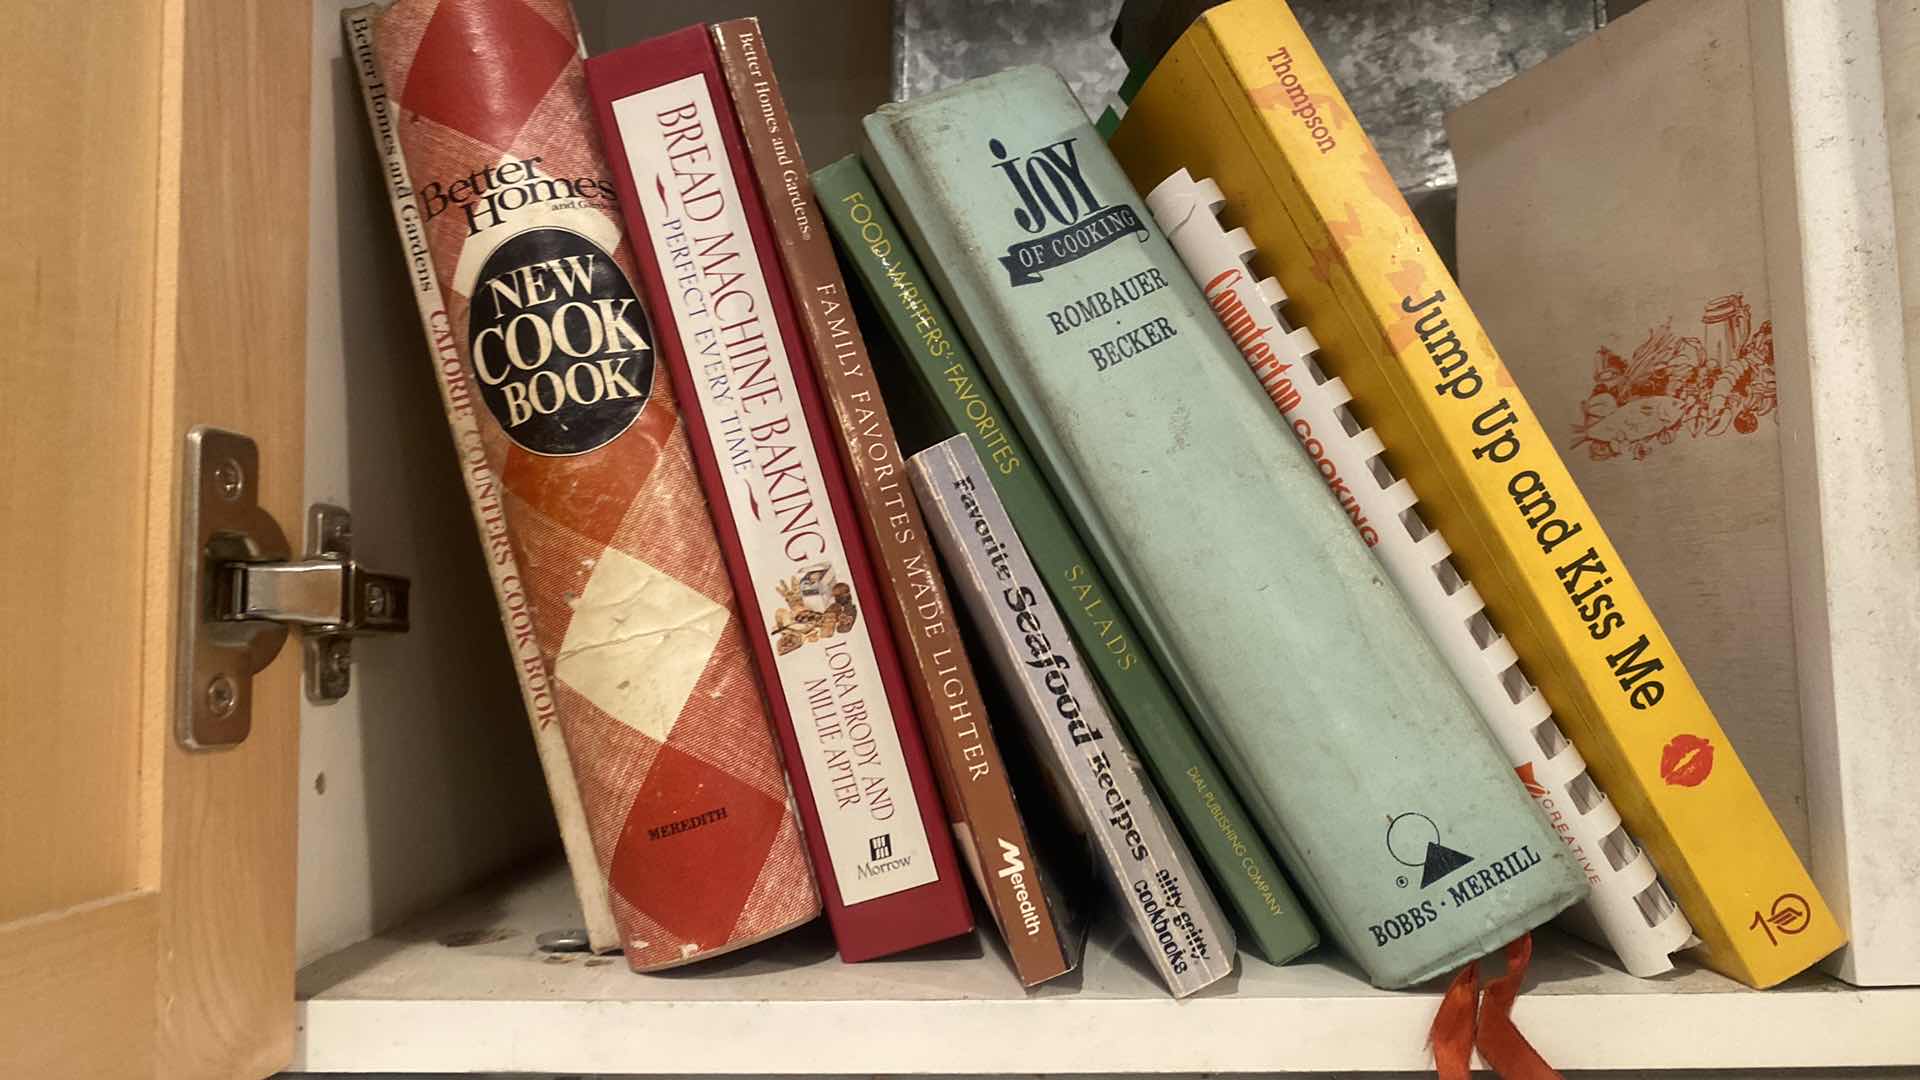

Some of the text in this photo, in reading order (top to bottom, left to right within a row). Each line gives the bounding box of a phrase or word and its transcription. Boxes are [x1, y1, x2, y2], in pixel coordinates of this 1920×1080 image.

[739, 31, 762, 77] Better
[754, 81, 778, 134] Homes
[772, 137, 793, 166] and
[1267, 47, 1337, 154] Thompson
[420, 156, 543, 223] Better
[462, 176, 617, 236] Homes
[1018, 208, 1137, 268] OF COOKING
[485, 254, 595, 319] NEW
[657, 101, 827, 565] BREAD MACHINE BAKING
[841, 191, 892, 257] FOOD
[944, 363, 1020, 475] FAVORITES
[1046, 267, 1169, 336] ROMBAUER
[473, 298, 651, 386] COOK
[501, 357, 643, 428] BOOK
[662, 218, 752, 475] PERFECT EVERY TIME
[1088, 316, 1178, 372] BECKER
[369, 83, 395, 157] Homes
[389, 159, 414, 200] and
[402, 203, 434, 293] Gardens
[430, 309, 474, 421] CALORIE
[462, 429, 512, 565] COUNTERS
[501, 575, 537, 653] COOK
[523, 654, 560, 731] BOOK
[816, 282, 990, 783] FAMILY FAVORITES MADE LIGHTER
[1293, 419, 1379, 549] COOKING
[1401, 289, 1664, 710] Jump Up and Kiss Me
[953, 475, 1013, 581] Favorite
[1003, 585, 1104, 748] Seafood
[1064, 564, 1137, 670] SALADS
[804, 678, 860, 811] MILLIE APTER
[824, 641, 895, 821] LORA BRODY AND
[647, 807, 729, 842] MEREDITH
[857, 856, 911, 880] Morrow
[1204, 792, 1247, 857] PUBLISHING
[1241, 857, 1284, 917] COMPANY
[1542, 798, 1601, 887] CREATIVE
[998, 837, 1041, 937] Meredith
[1134, 880, 1188, 975] cookbooks
[1369, 845, 1542, 948] BOBBS MERRILL
